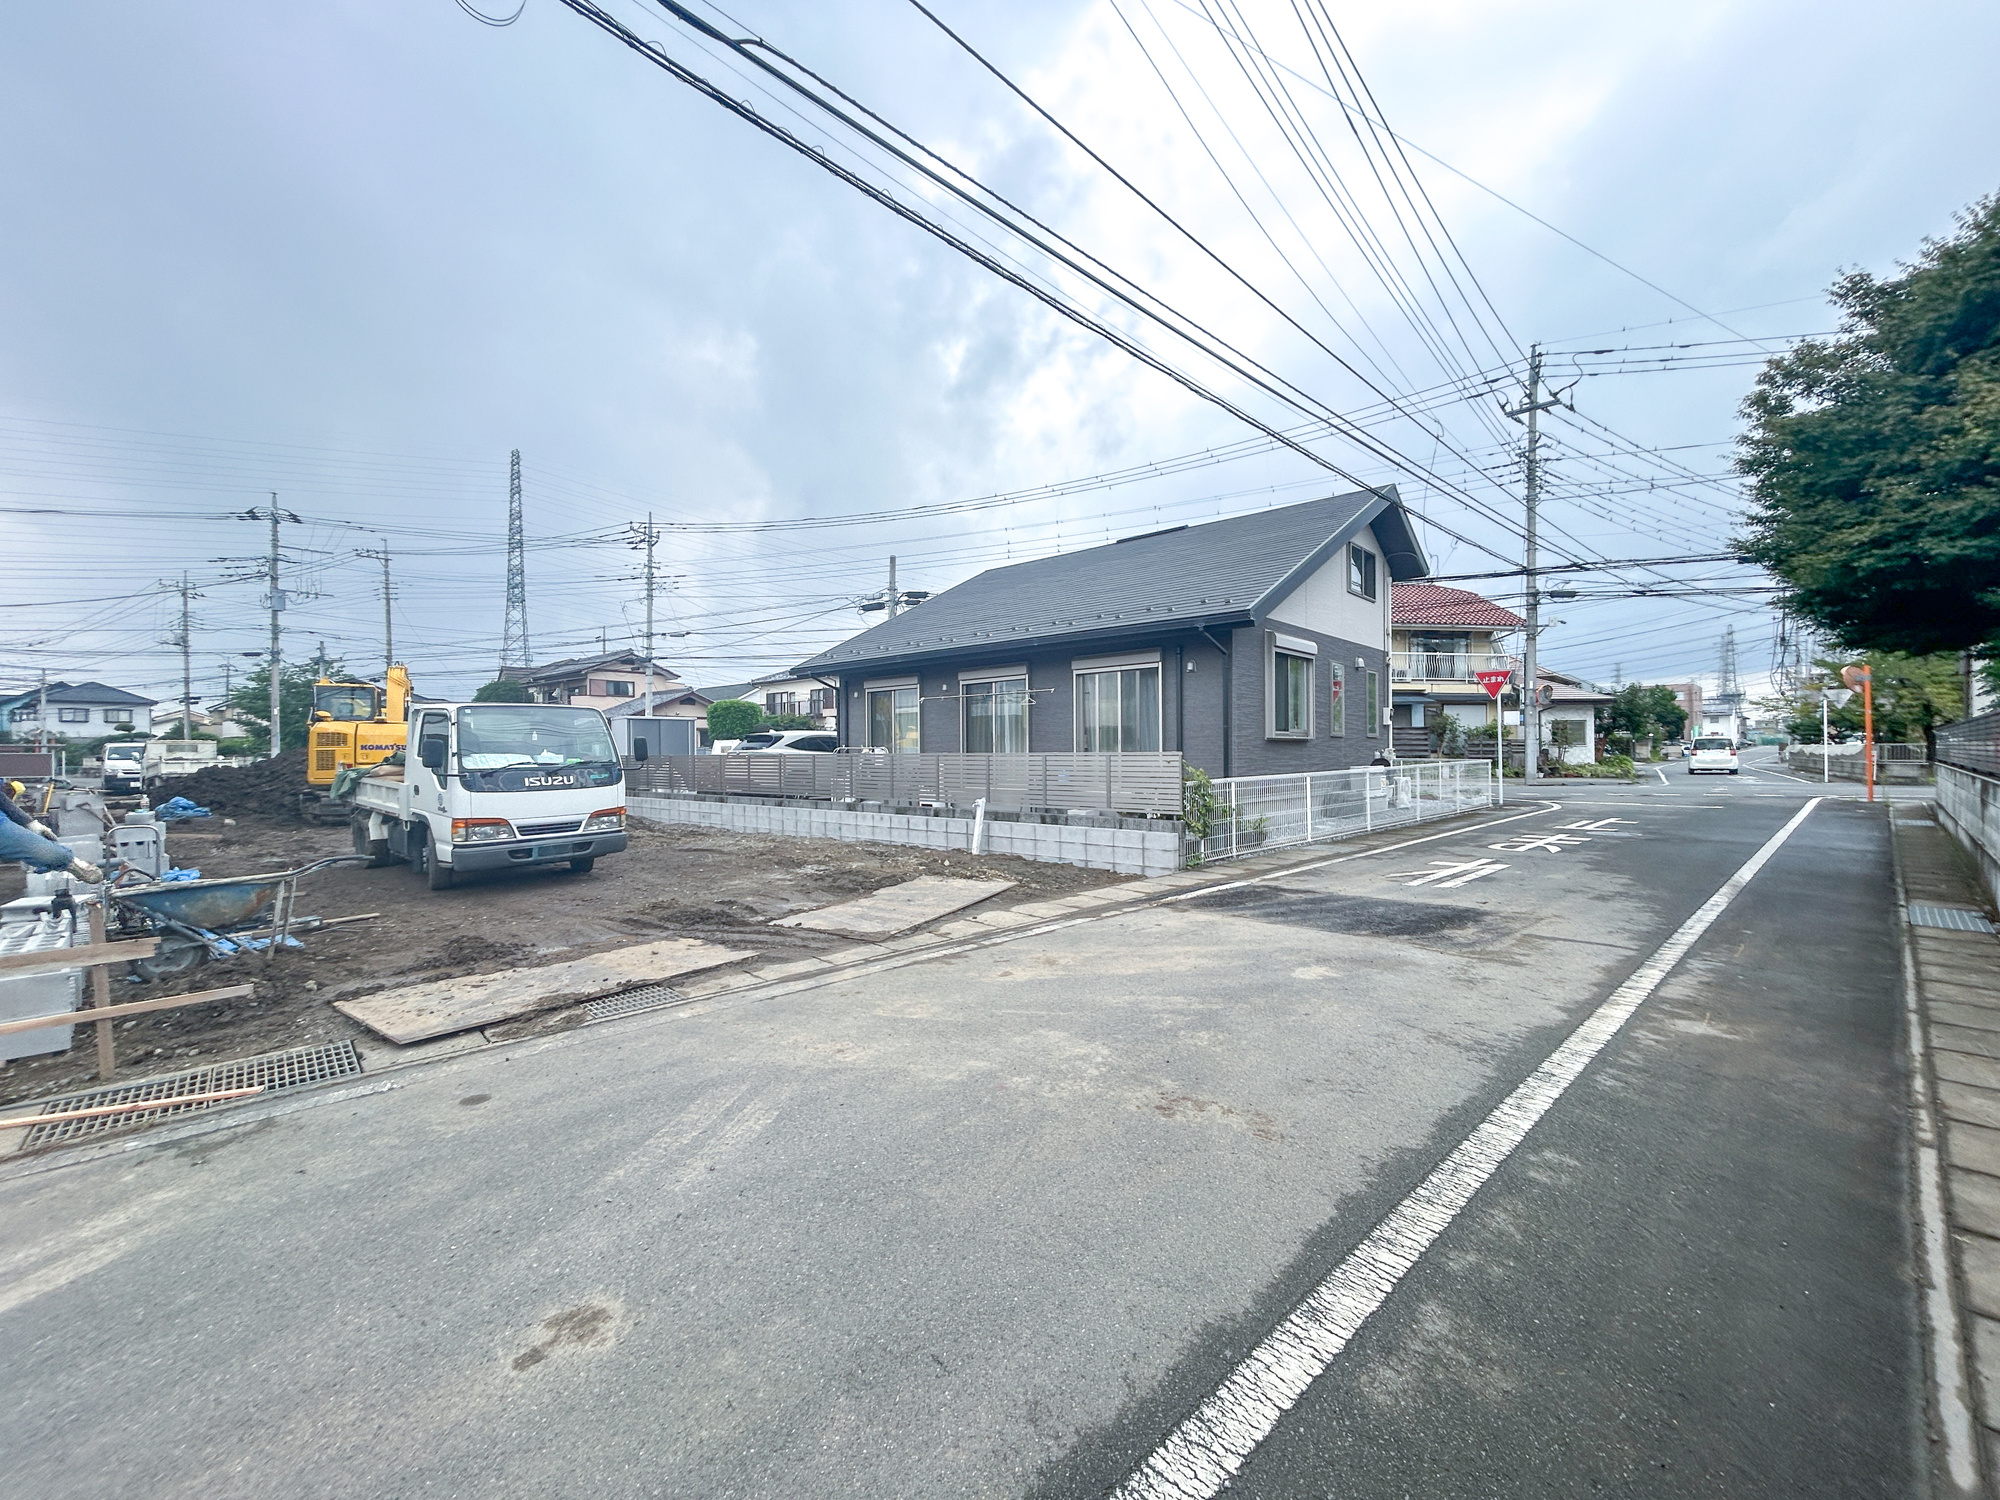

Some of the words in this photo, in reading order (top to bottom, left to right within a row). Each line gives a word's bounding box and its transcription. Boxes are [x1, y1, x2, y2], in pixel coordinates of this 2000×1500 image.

[1482, 675, 1505, 684] 止まれ
[360, 743, 407, 751] KOMATSU
[524, 775, 574, 787] ISUZU
[1383, 817, 1639, 889] 止まれ
